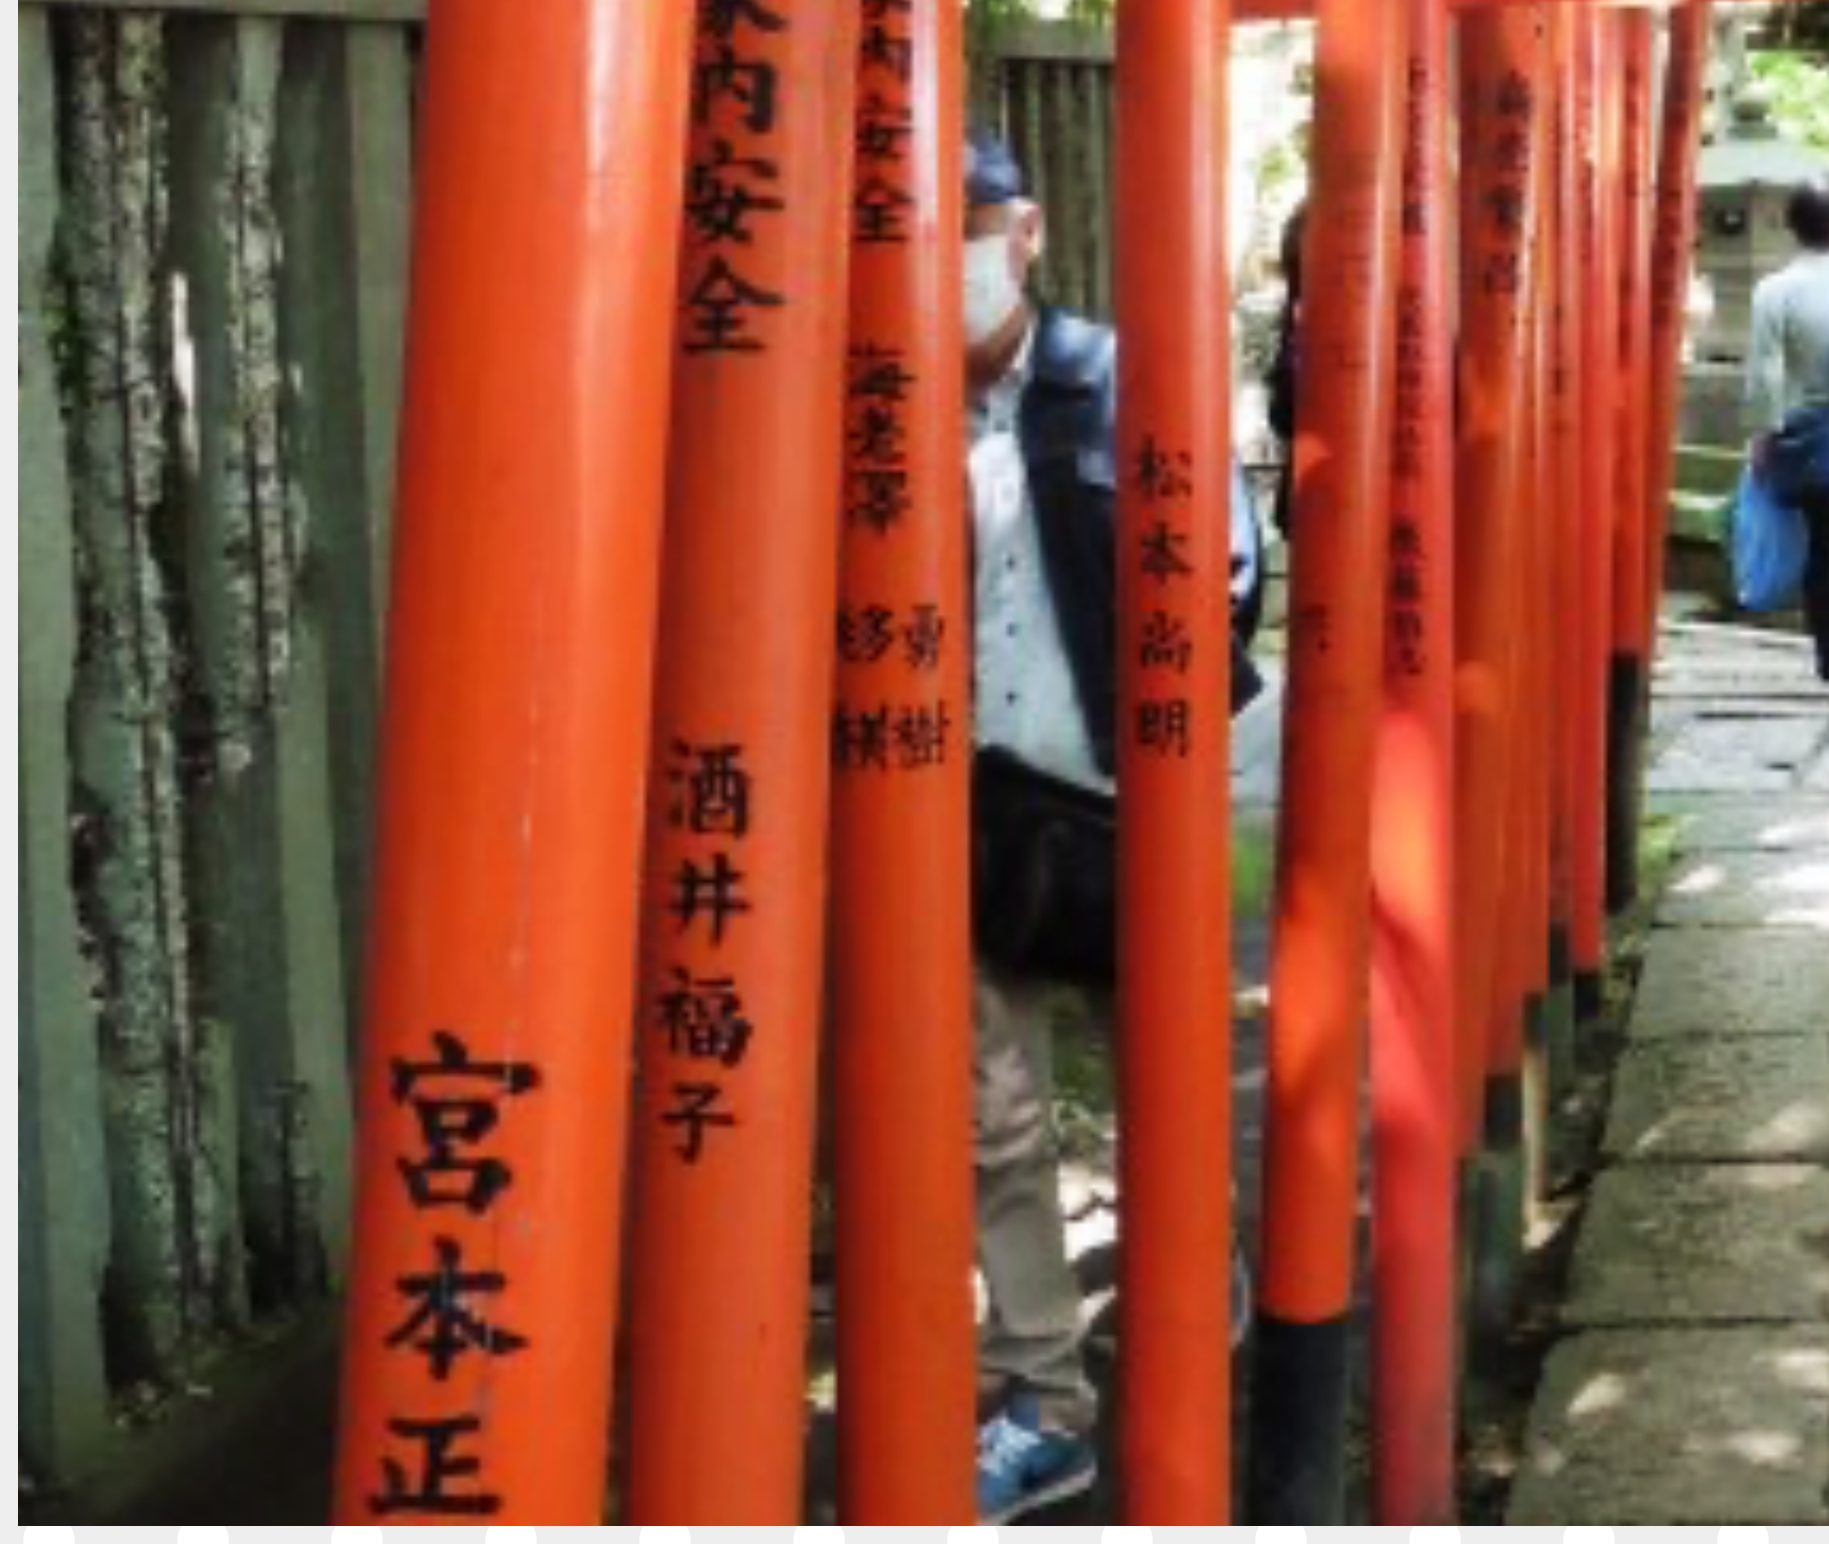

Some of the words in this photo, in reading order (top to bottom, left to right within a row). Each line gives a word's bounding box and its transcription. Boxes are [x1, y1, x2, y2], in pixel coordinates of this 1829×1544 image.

[657, 738, 754, 1166] 酒井福子
[366, 1030, 544, 1518] 宮本正
